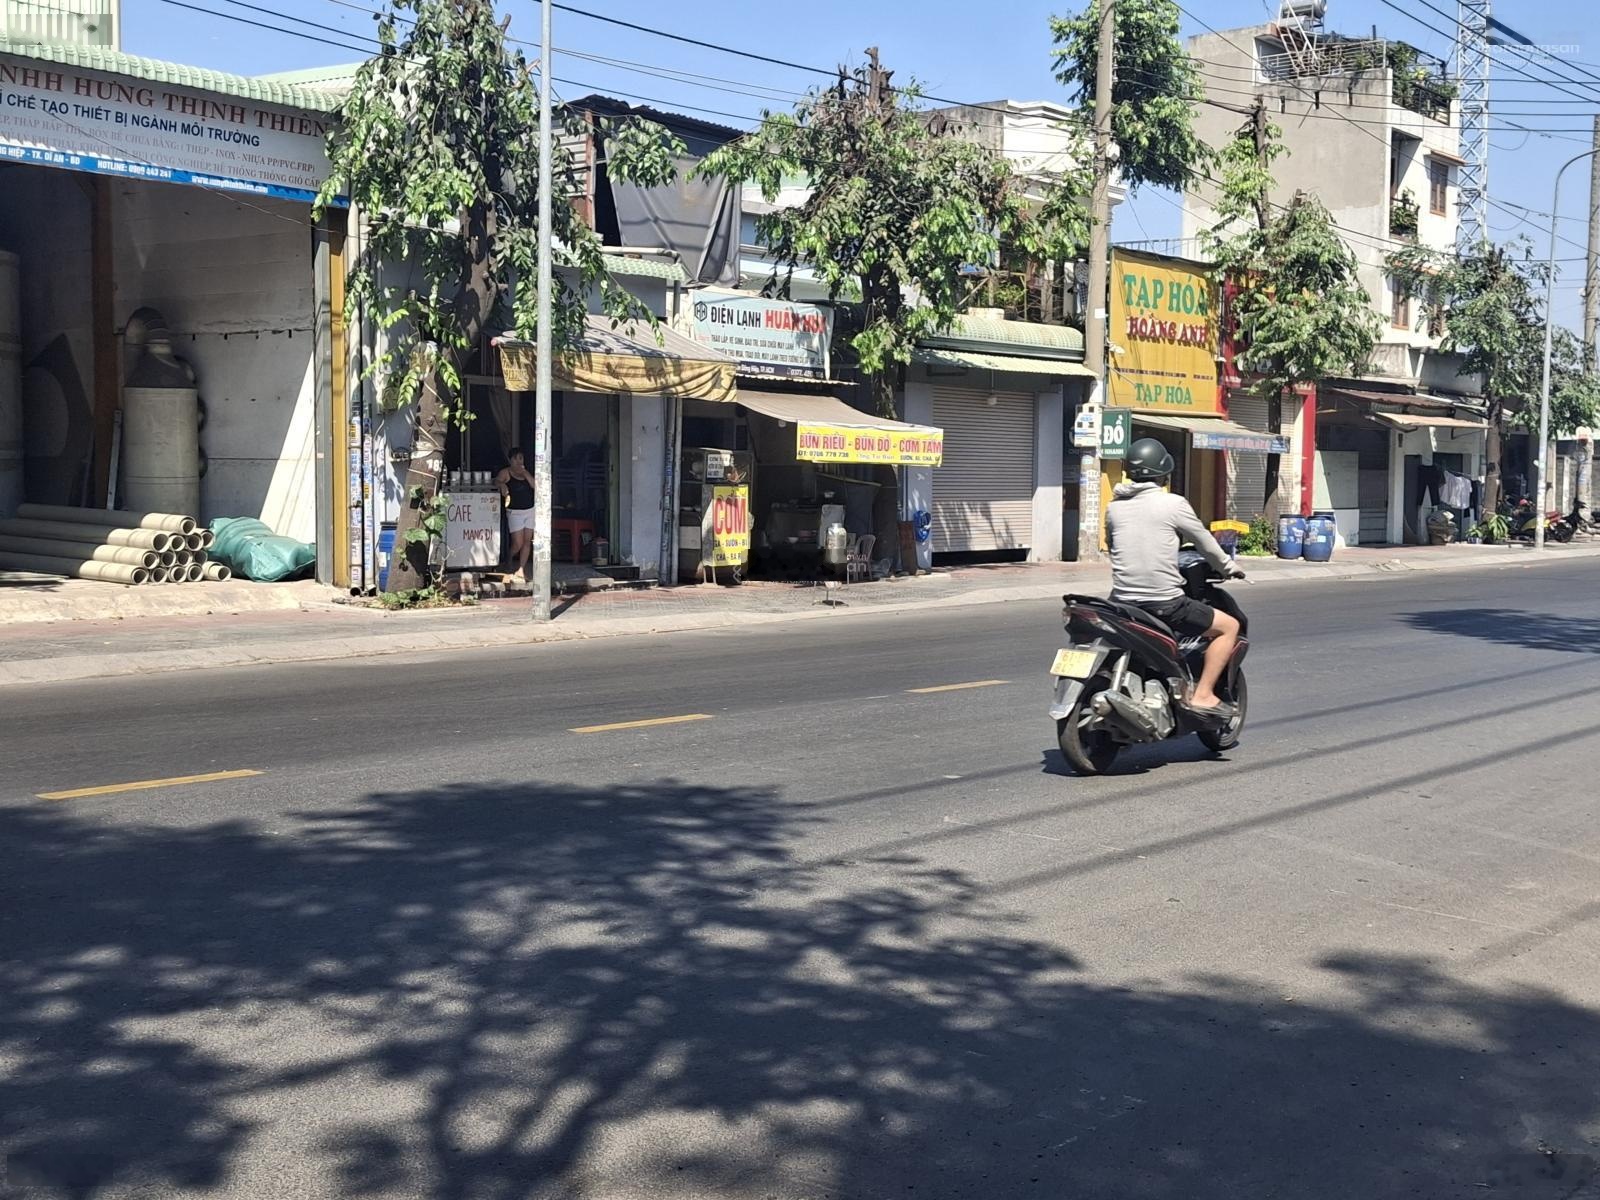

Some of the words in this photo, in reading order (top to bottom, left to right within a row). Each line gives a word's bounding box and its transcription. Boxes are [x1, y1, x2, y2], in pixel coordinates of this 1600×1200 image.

[73, 75, 154, 108] HƯNG
[162, 91, 246, 125] THỊNH
[7, 93, 36, 109] CHẾ
[40, 98, 69, 116] TẠO
[73, 103, 111, 121] THIẾT
[115, 111, 128, 127] BỊ
[131, 114, 177, 132] NGÀNH
[181, 121, 204, 137] MÔI
[208, 127, 260, 147] TRƯỜNG
[216, 149, 236, 160] INOX
[1123, 273, 1164, 315] TẠP
[1168, 274, 1209, 317] HÓA
[710, 304, 734, 328] ĐIỆN
[736, 309, 761, 331] LẠNH
[1127, 312, 1176, 341] HOÀNG
[1180, 323, 1208, 344] ANH
[1135, 382, 1162, 407] TẠP
[1164, 380, 1193, 405] HÓA
[822, 432, 845, 450] RIÊU
[447, 504, 472, 522] CAFE
